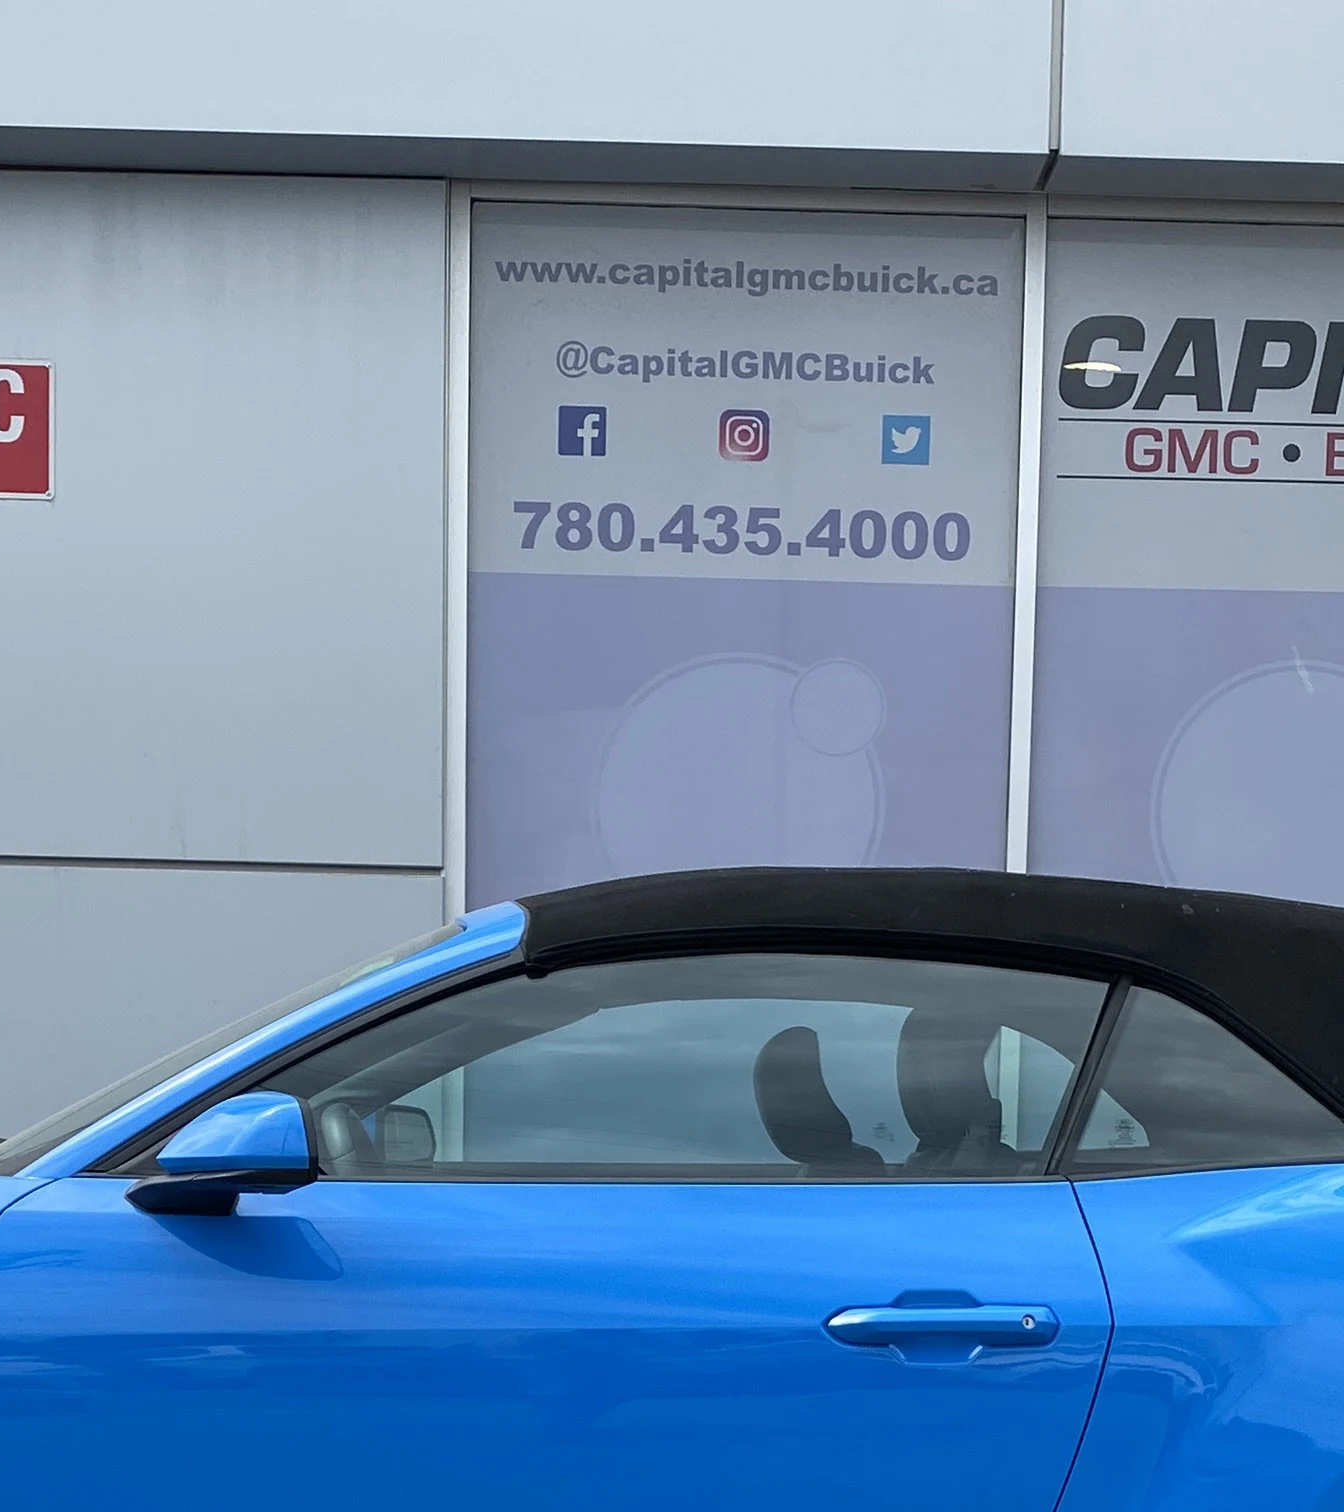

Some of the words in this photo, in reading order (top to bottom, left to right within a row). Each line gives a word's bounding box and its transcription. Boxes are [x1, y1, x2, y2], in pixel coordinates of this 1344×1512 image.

[495, 258, 999, 297] www.capitalgmcbuick.ca
[555, 340, 936, 385] @CapitalGMCBuick
[1124, 427, 1260, 476] GMC
[512, 500, 971, 562] 780.435.4000
